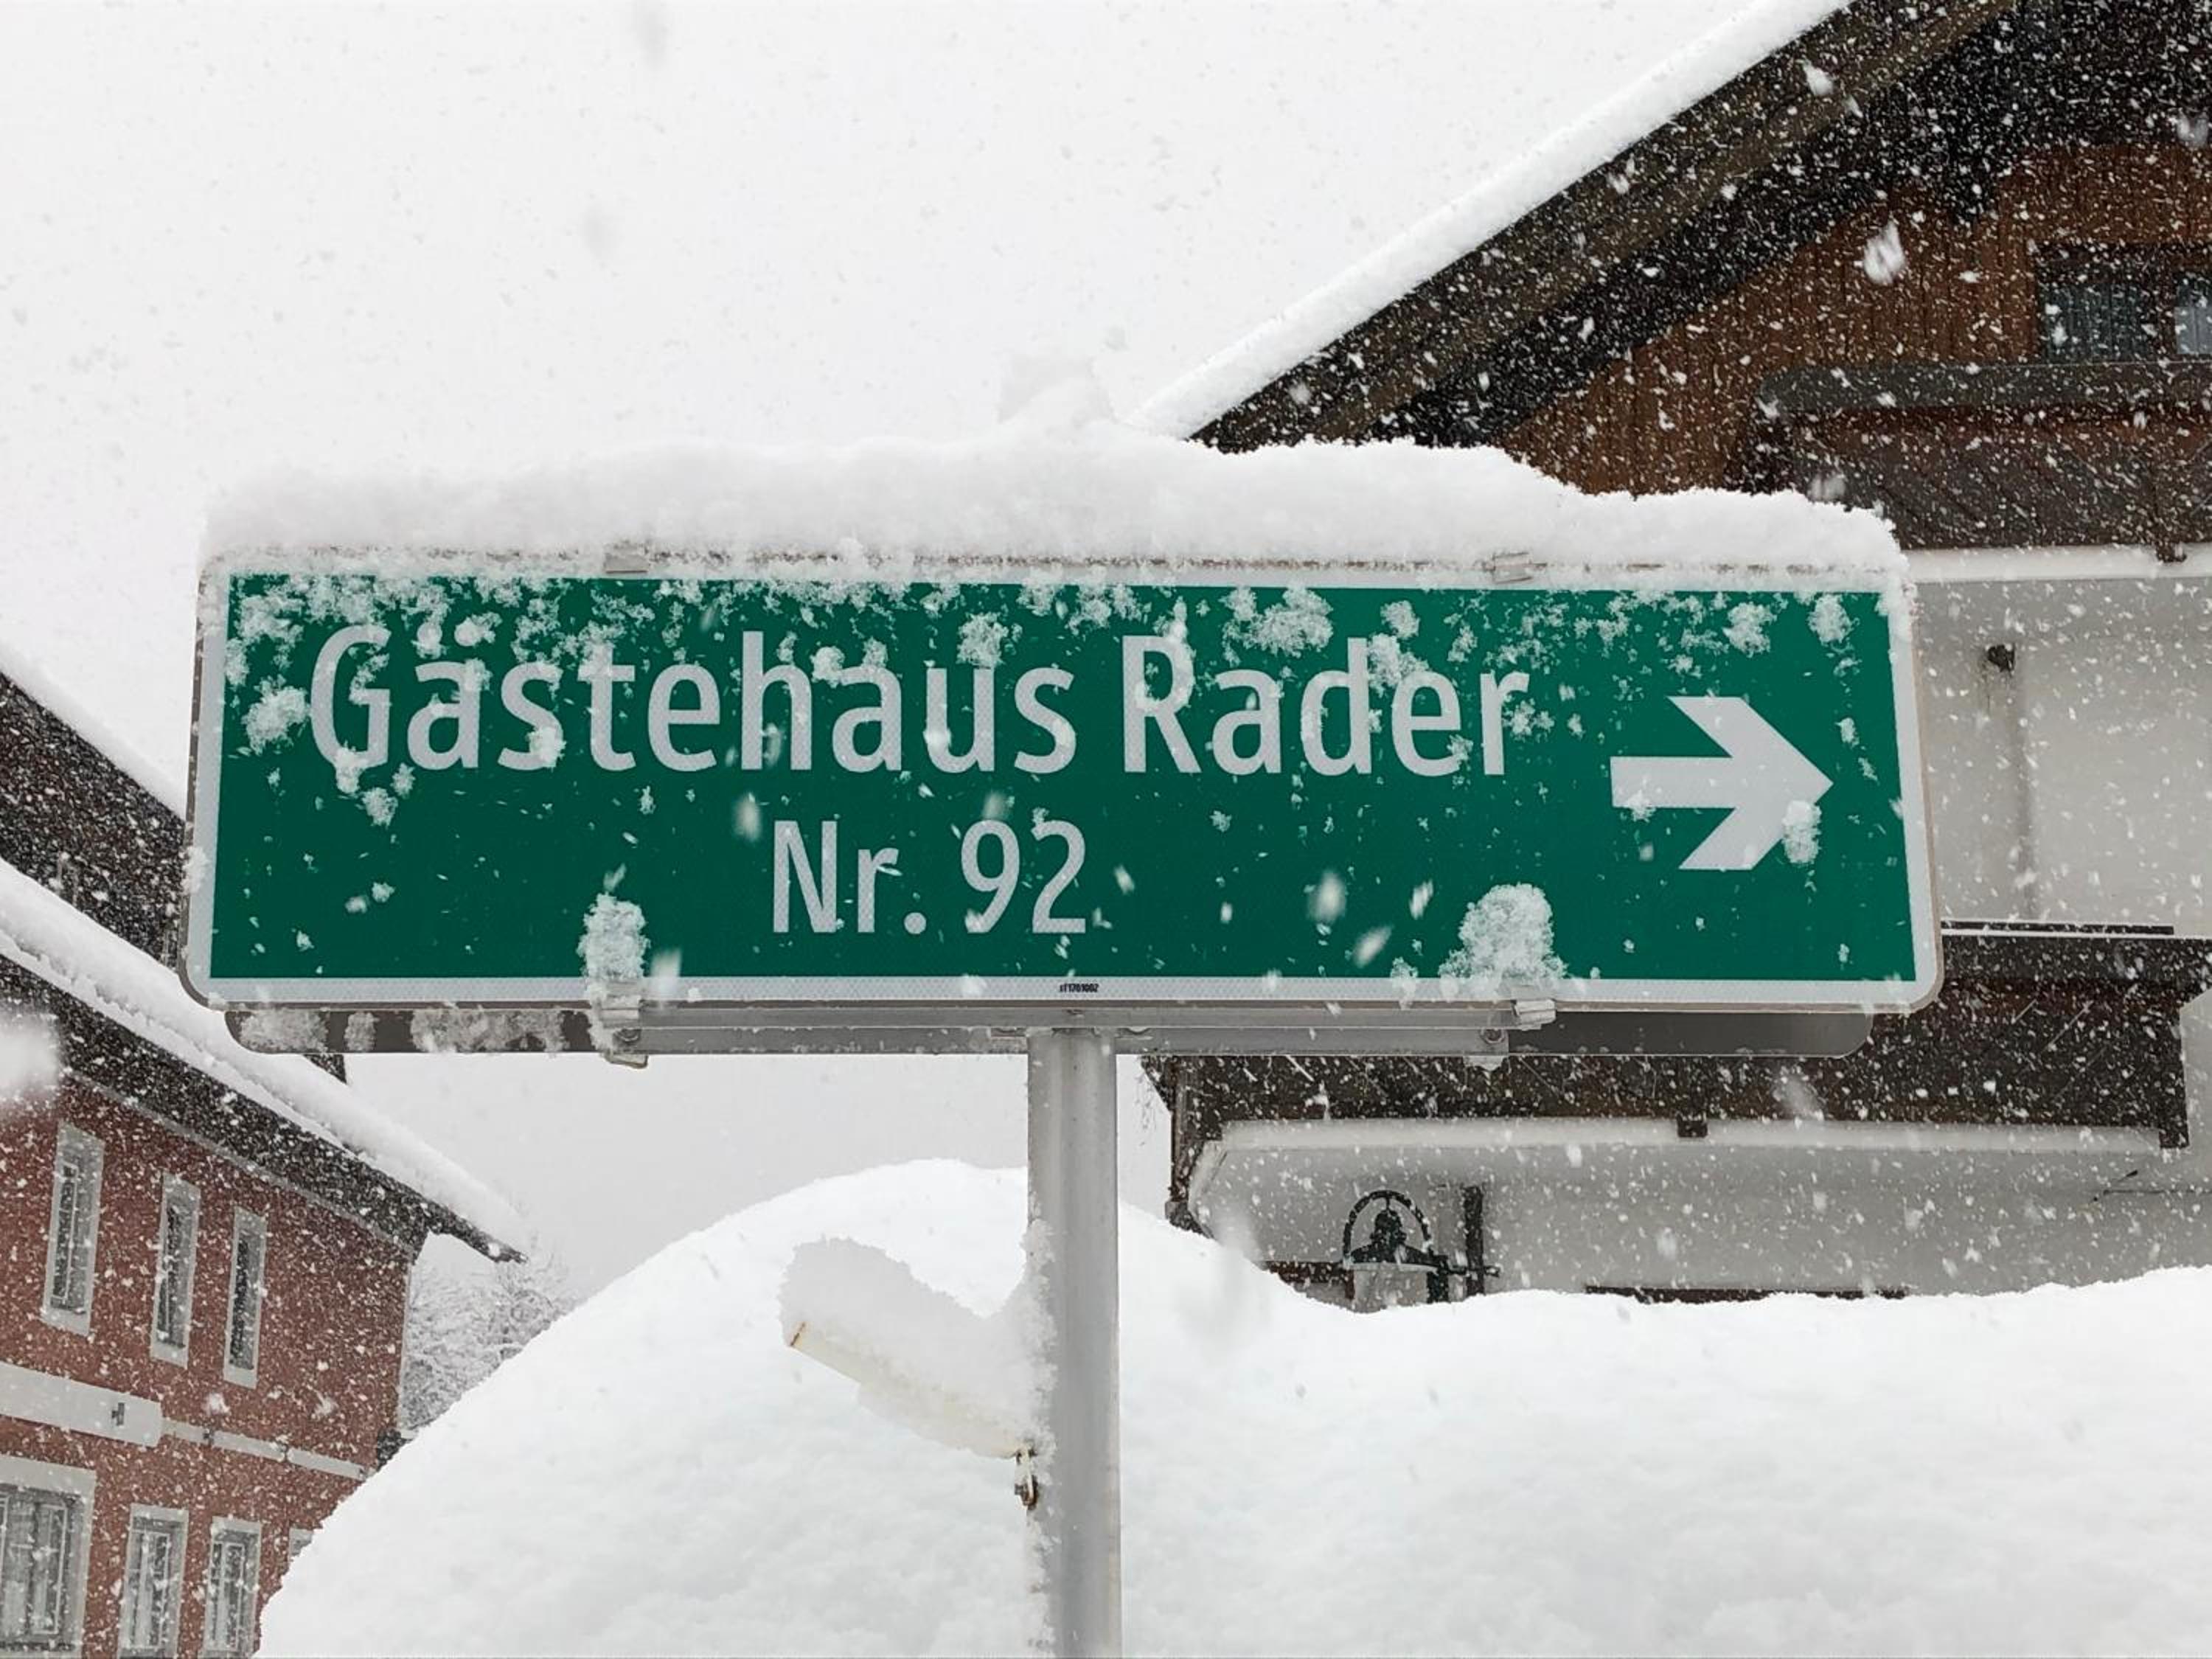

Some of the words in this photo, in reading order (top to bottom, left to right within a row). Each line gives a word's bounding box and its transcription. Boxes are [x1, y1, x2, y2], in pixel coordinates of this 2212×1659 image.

[310, 624, 1077, 773] Gästehaus
[1121, 635, 1530, 776] Rader
[773, 819, 927, 935] Nr.
[961, 820, 1086, 934] 92
